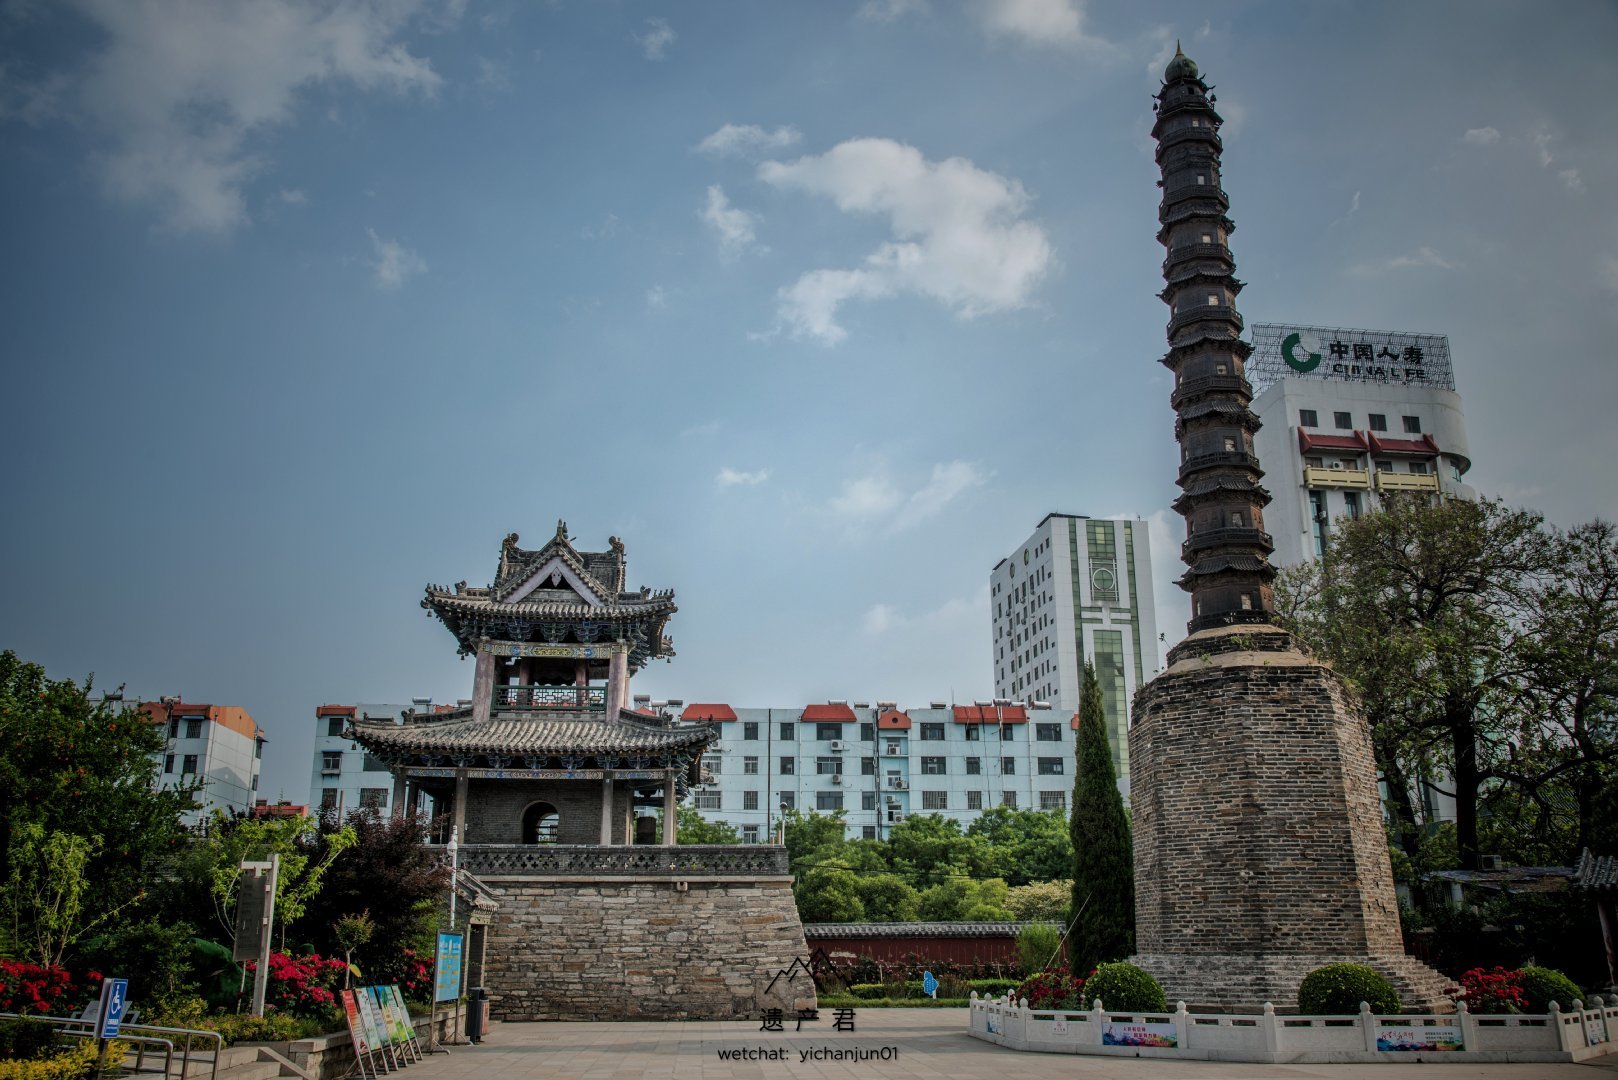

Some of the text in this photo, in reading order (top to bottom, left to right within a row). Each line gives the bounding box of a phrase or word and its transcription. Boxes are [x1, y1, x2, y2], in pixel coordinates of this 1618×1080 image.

[1330, 341, 1424, 364] 中国人寿
[1391, 367, 1425, 379] LFE
